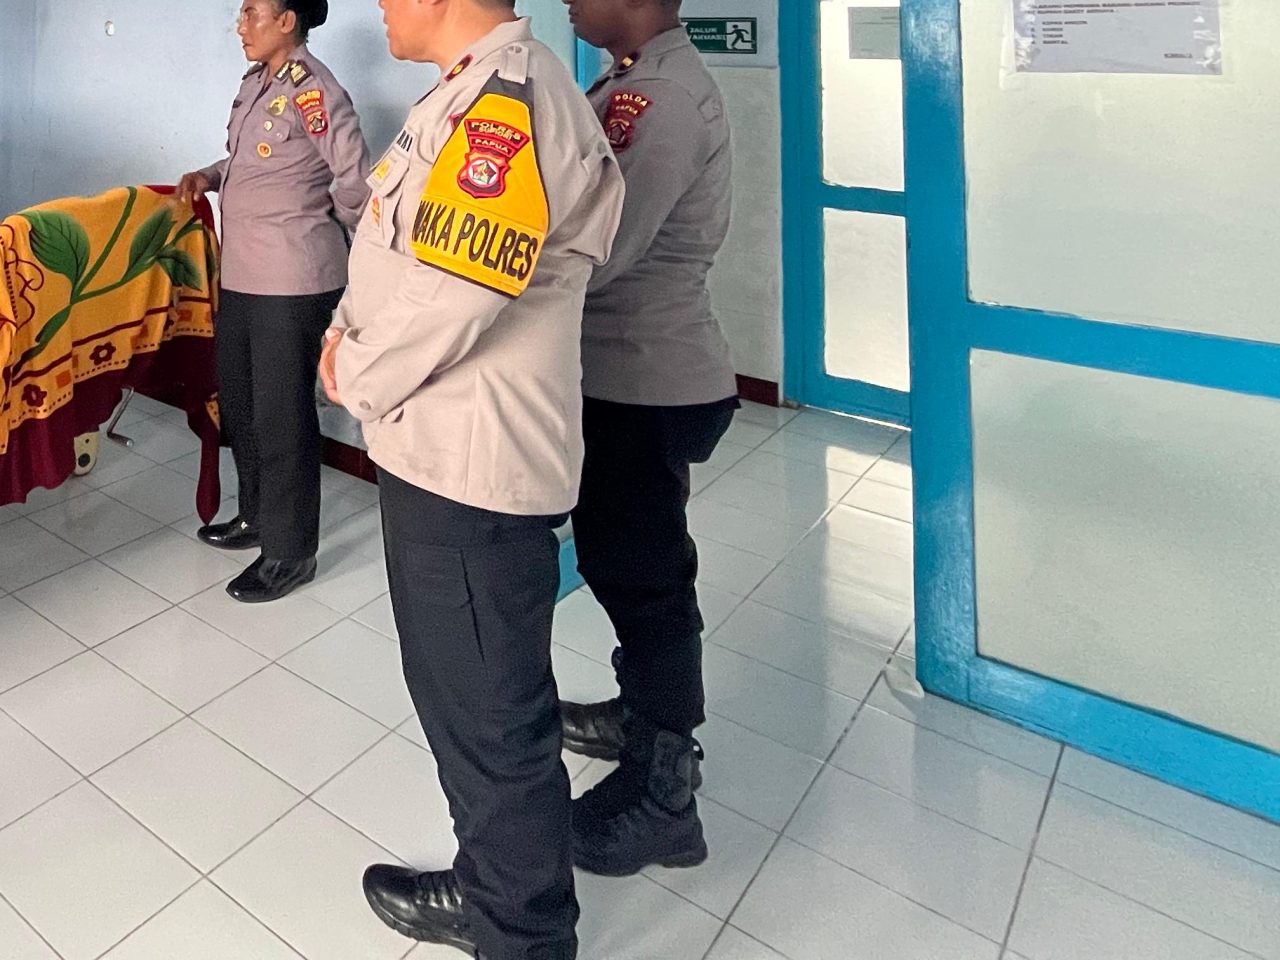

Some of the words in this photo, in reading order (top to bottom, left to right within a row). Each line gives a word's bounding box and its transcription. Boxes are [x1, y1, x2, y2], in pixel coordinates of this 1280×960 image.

[614, 93, 649, 108] POLDA
[470, 121, 522, 141] POLRES
[474, 138, 509, 153] PAPUA
[453, 212, 539, 282] POLRES
